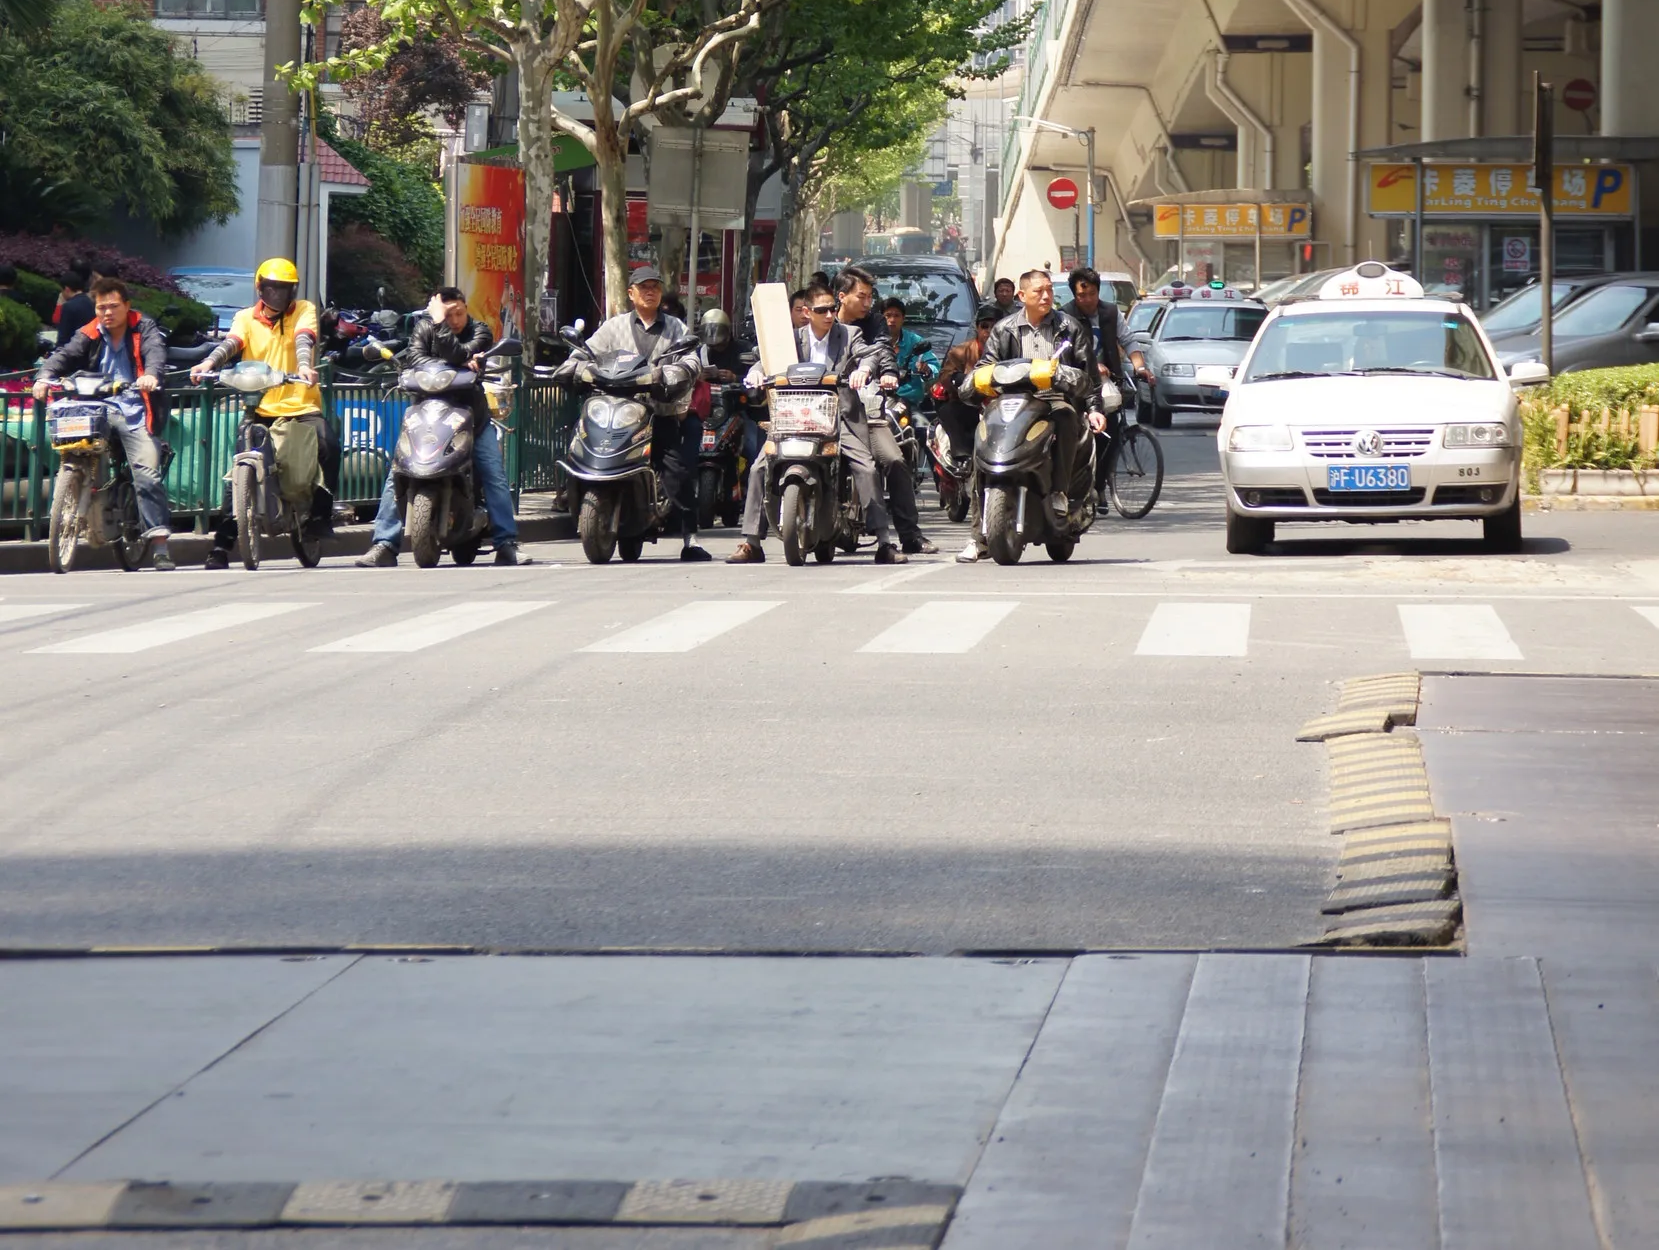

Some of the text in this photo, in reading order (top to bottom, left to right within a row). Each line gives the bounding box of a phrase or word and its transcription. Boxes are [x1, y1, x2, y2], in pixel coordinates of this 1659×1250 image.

[1591, 168, 1623, 209] P
[1425, 197, 1472, 208] arLing
[1475, 197, 1507, 208] Ting
[1287, 208, 1306, 232] P
